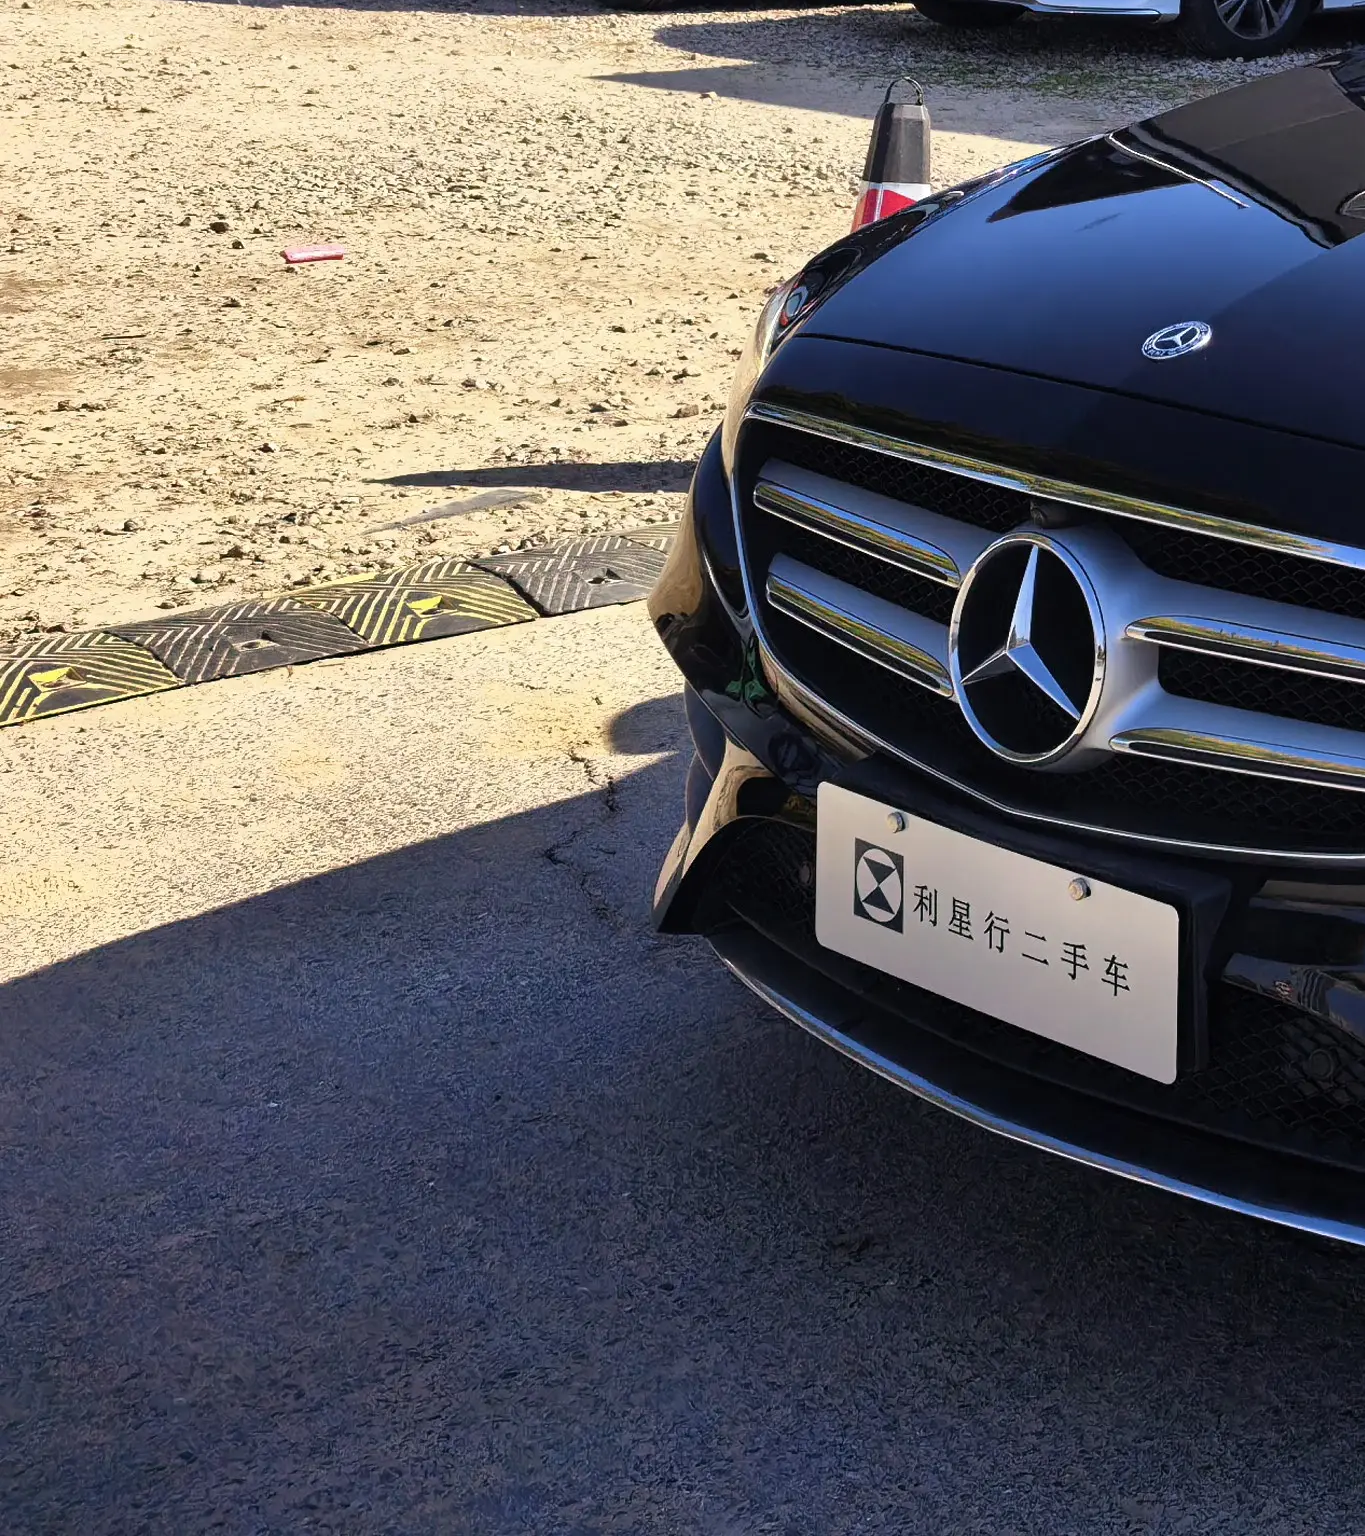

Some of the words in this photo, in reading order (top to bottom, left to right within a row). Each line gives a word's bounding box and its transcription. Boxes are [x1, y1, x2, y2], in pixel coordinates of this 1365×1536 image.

[912, 884, 1131, 997] 利星行二手车
